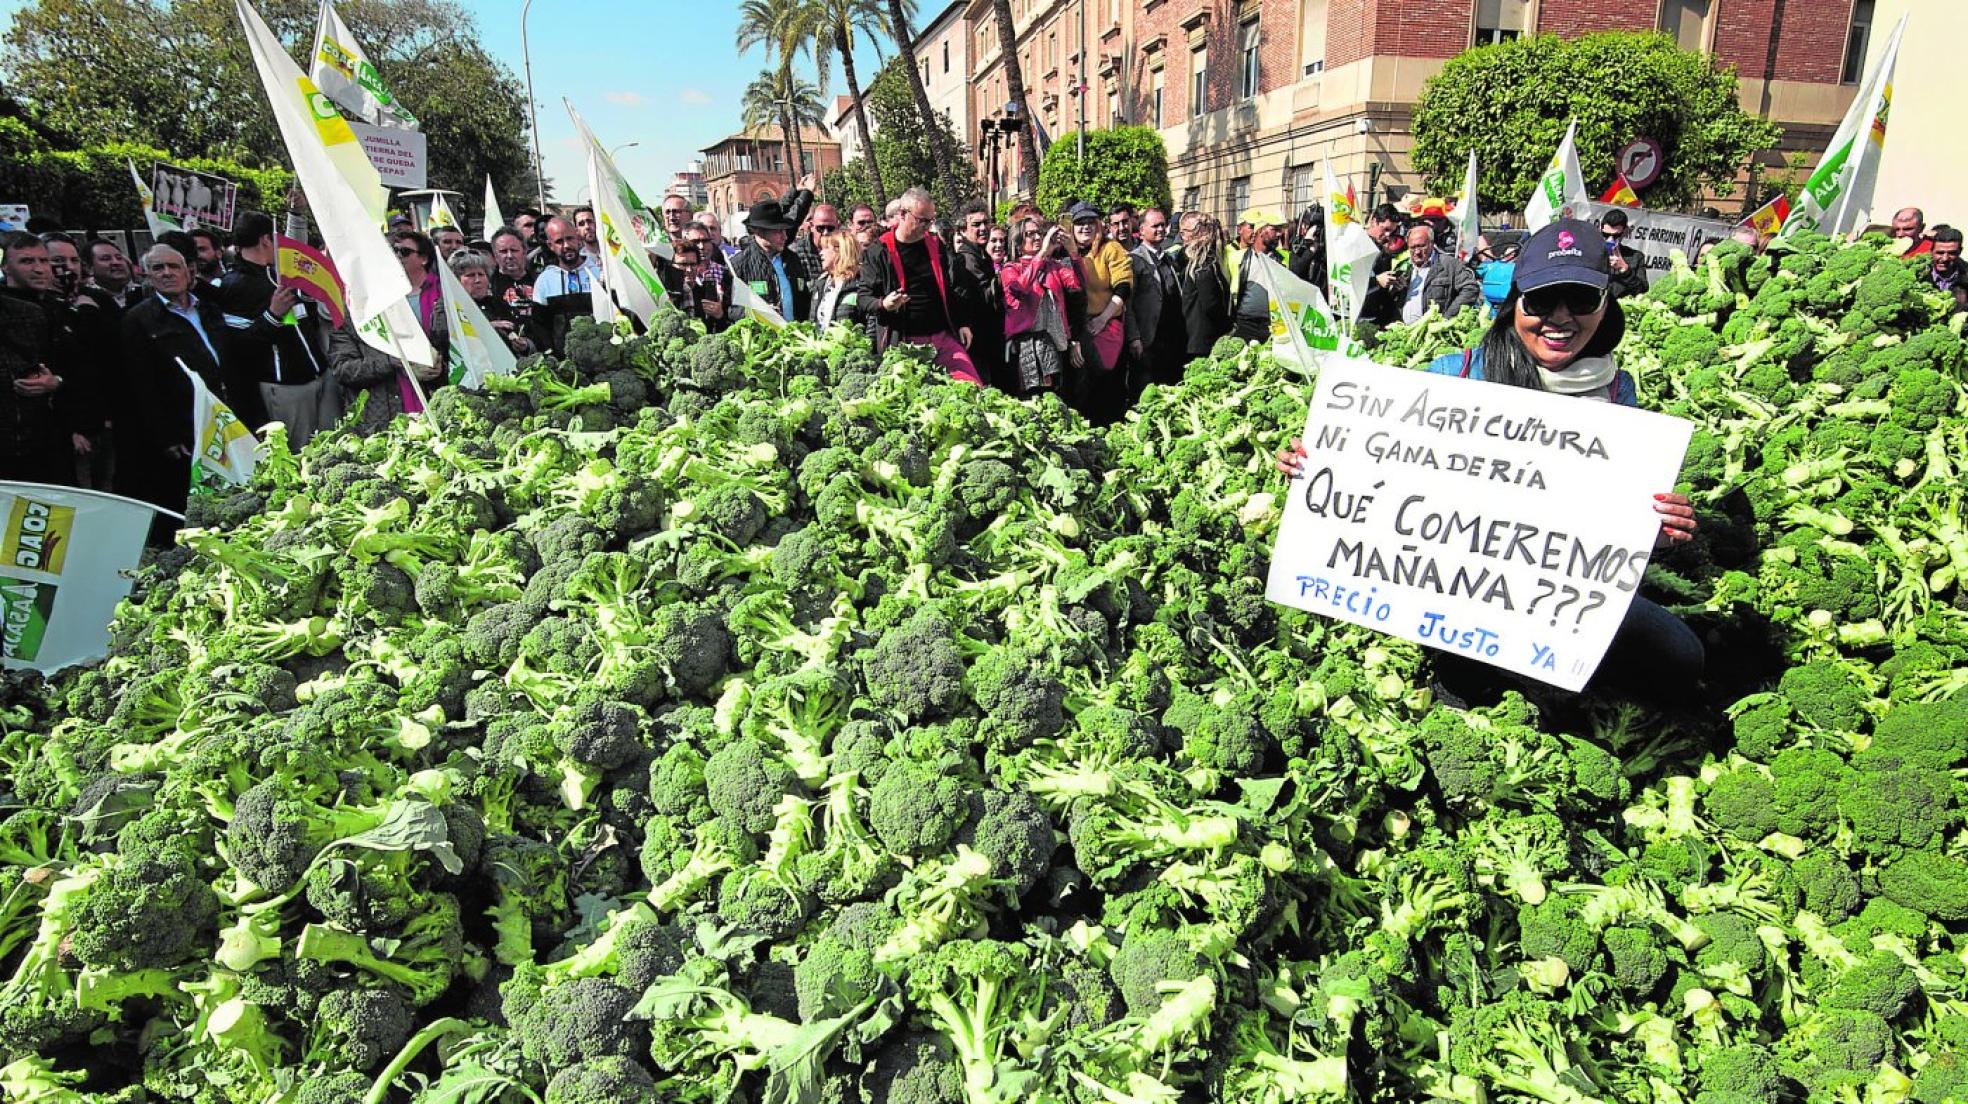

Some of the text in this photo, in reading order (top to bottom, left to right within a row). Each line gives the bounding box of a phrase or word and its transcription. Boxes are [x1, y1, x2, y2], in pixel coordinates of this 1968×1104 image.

[364, 135, 401, 146] JUMILLA
[366, 145, 415, 158] TIERRA DEL
[373, 156, 385, 164] SE
[387, 158, 416, 168] QUEDA
[377, 166, 406, 177] CEPAS
[1364, 431, 1547, 490] GANADERÍA
[1305, 467, 1651, 592] QUÉ COMEREMOS
[1531, 642, 1555, 671] YA
